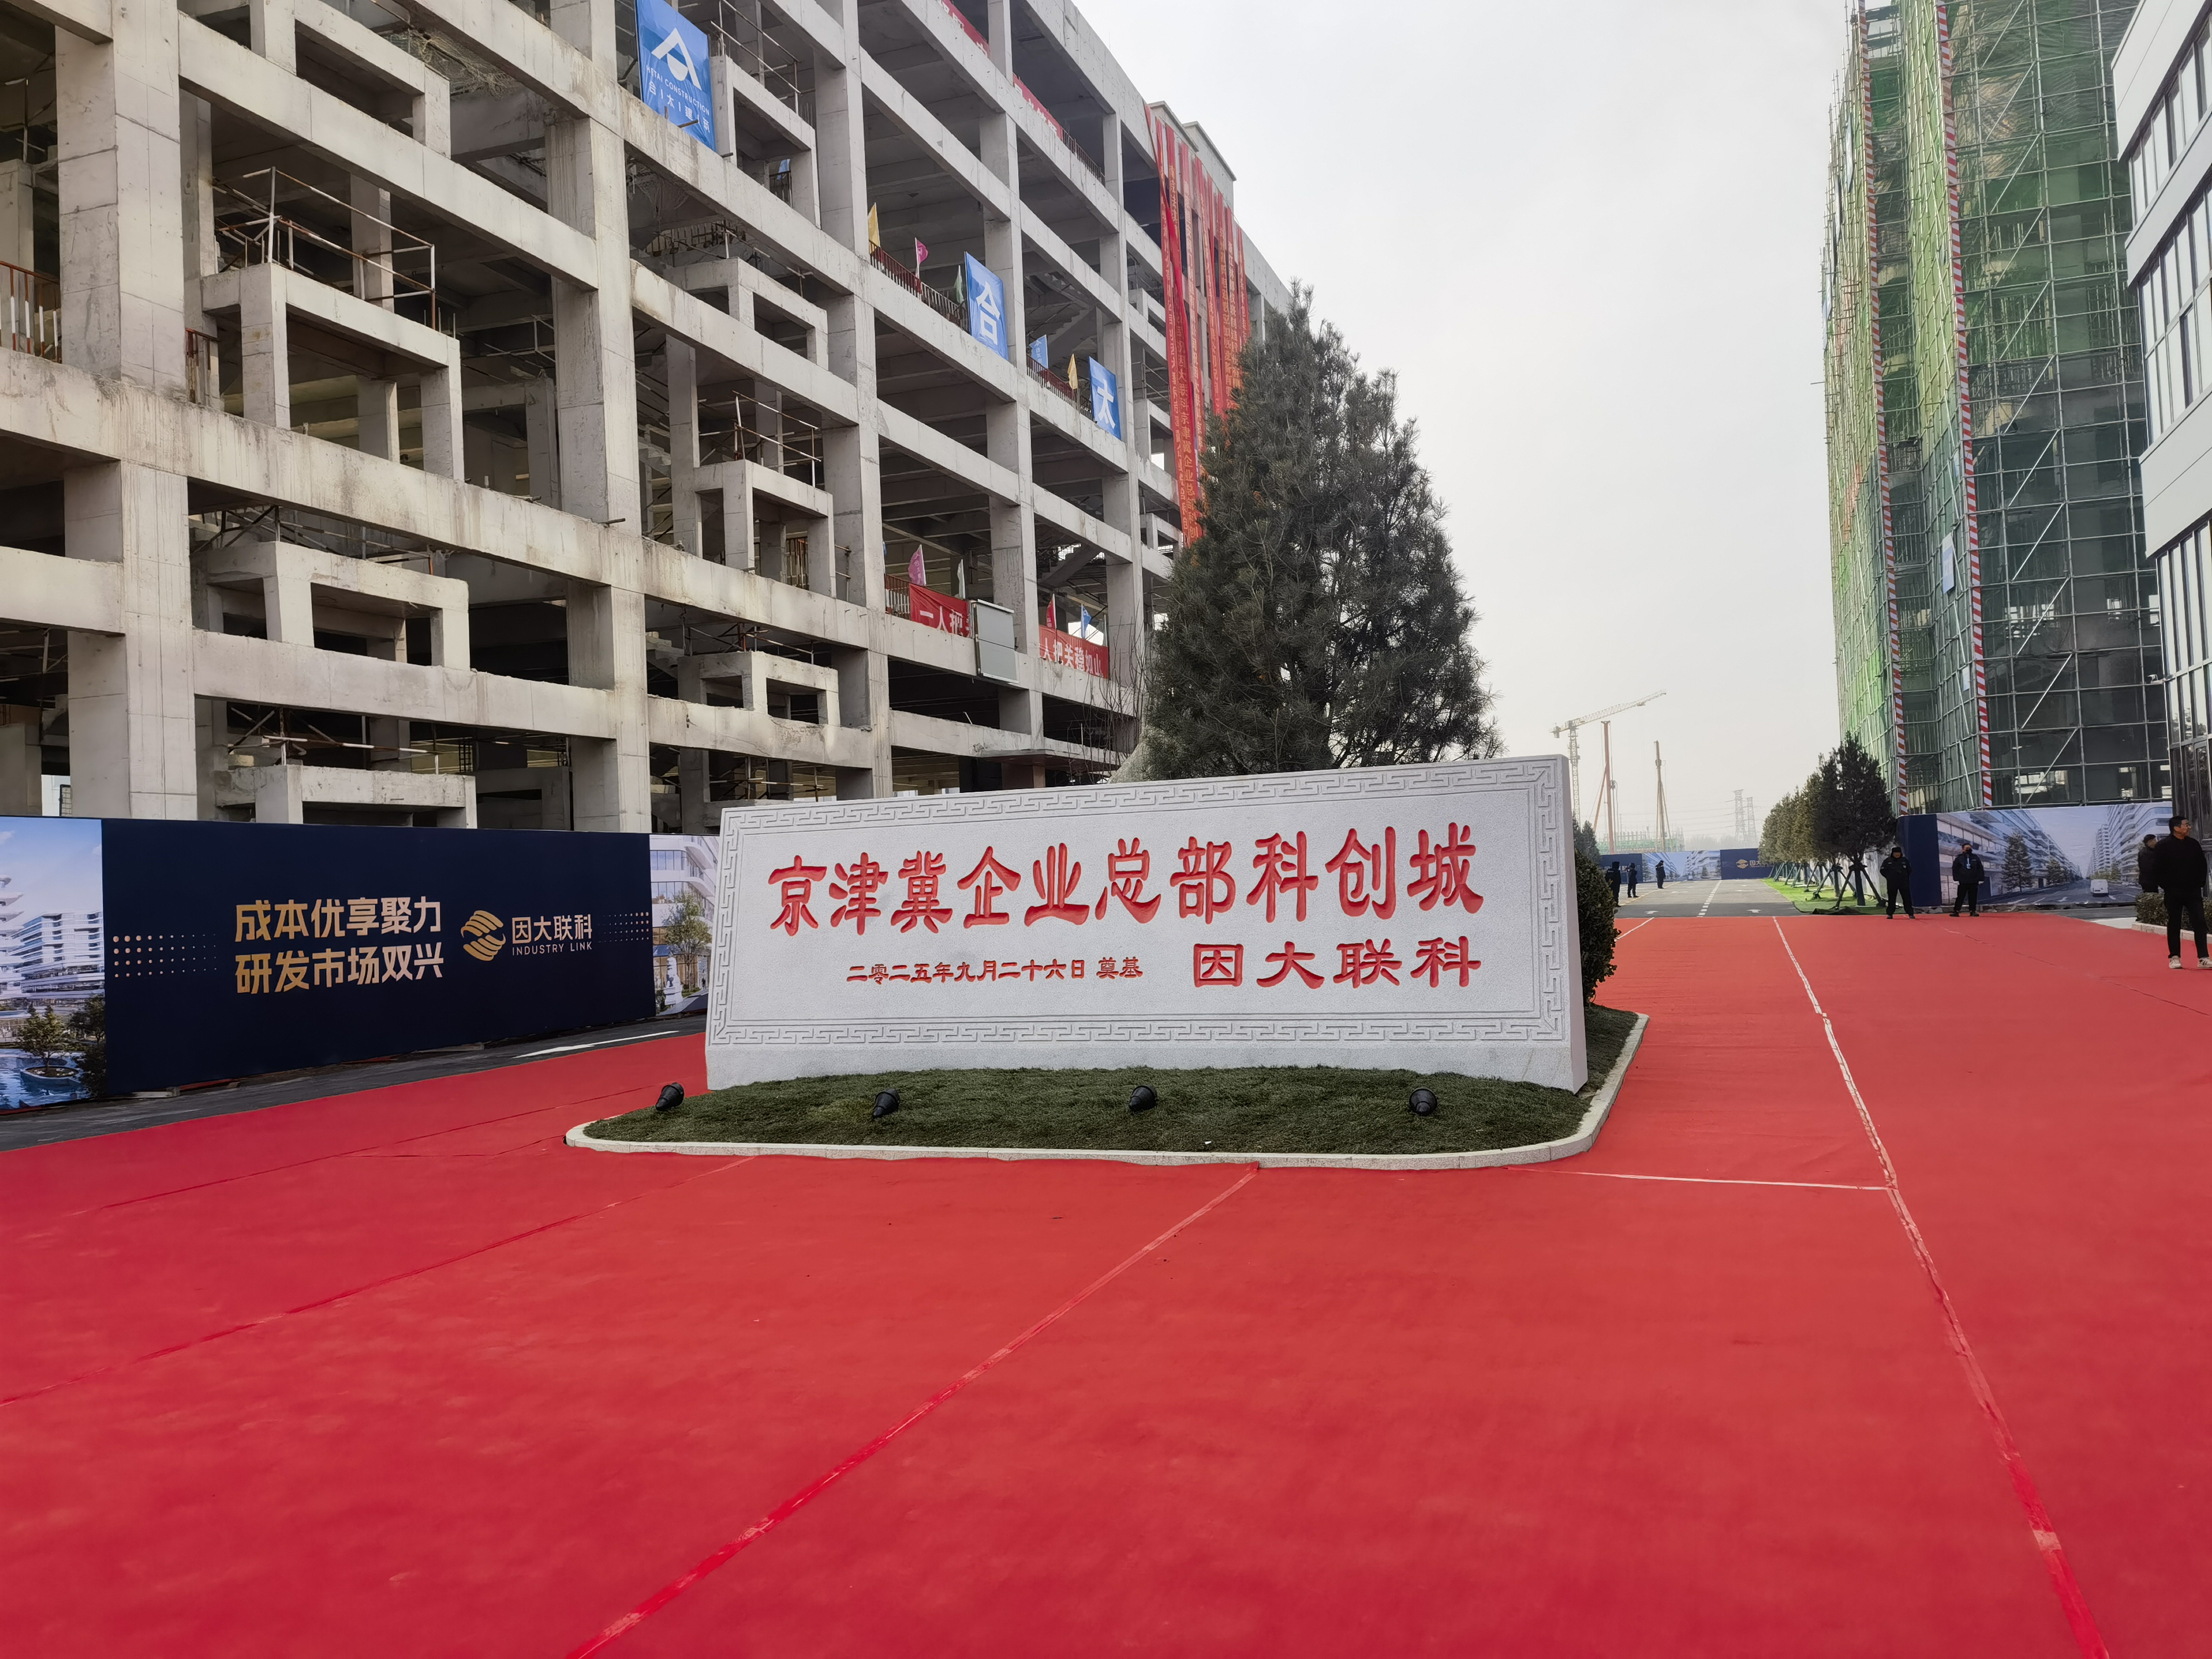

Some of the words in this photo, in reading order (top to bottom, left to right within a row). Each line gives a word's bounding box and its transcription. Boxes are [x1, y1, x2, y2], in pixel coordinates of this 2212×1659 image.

[646, 64, 663, 83] HETAI
[665, 78, 710, 116] CONSTRUCTION
[976, 281, 1000, 346] 合
[1097, 379, 1116, 429] 太
[919, 605, 970, 635] 一人把
[768, 822, 1483, 936] 京津冀企业总部科创城
[235, 896, 441, 942] 成本优享聚力
[512, 914, 592, 944] 因大联科
[236, 942, 444, 995] 研发市场双兴
[512, 943, 564, 956] INDUSTRY
[570, 941, 592, 952] LINK
[847, 959, 1085, 984] 二零二五年九月二十六日
[1096, 957, 1143, 979] 奠基
[1193, 935, 1481, 989] 因大联科
